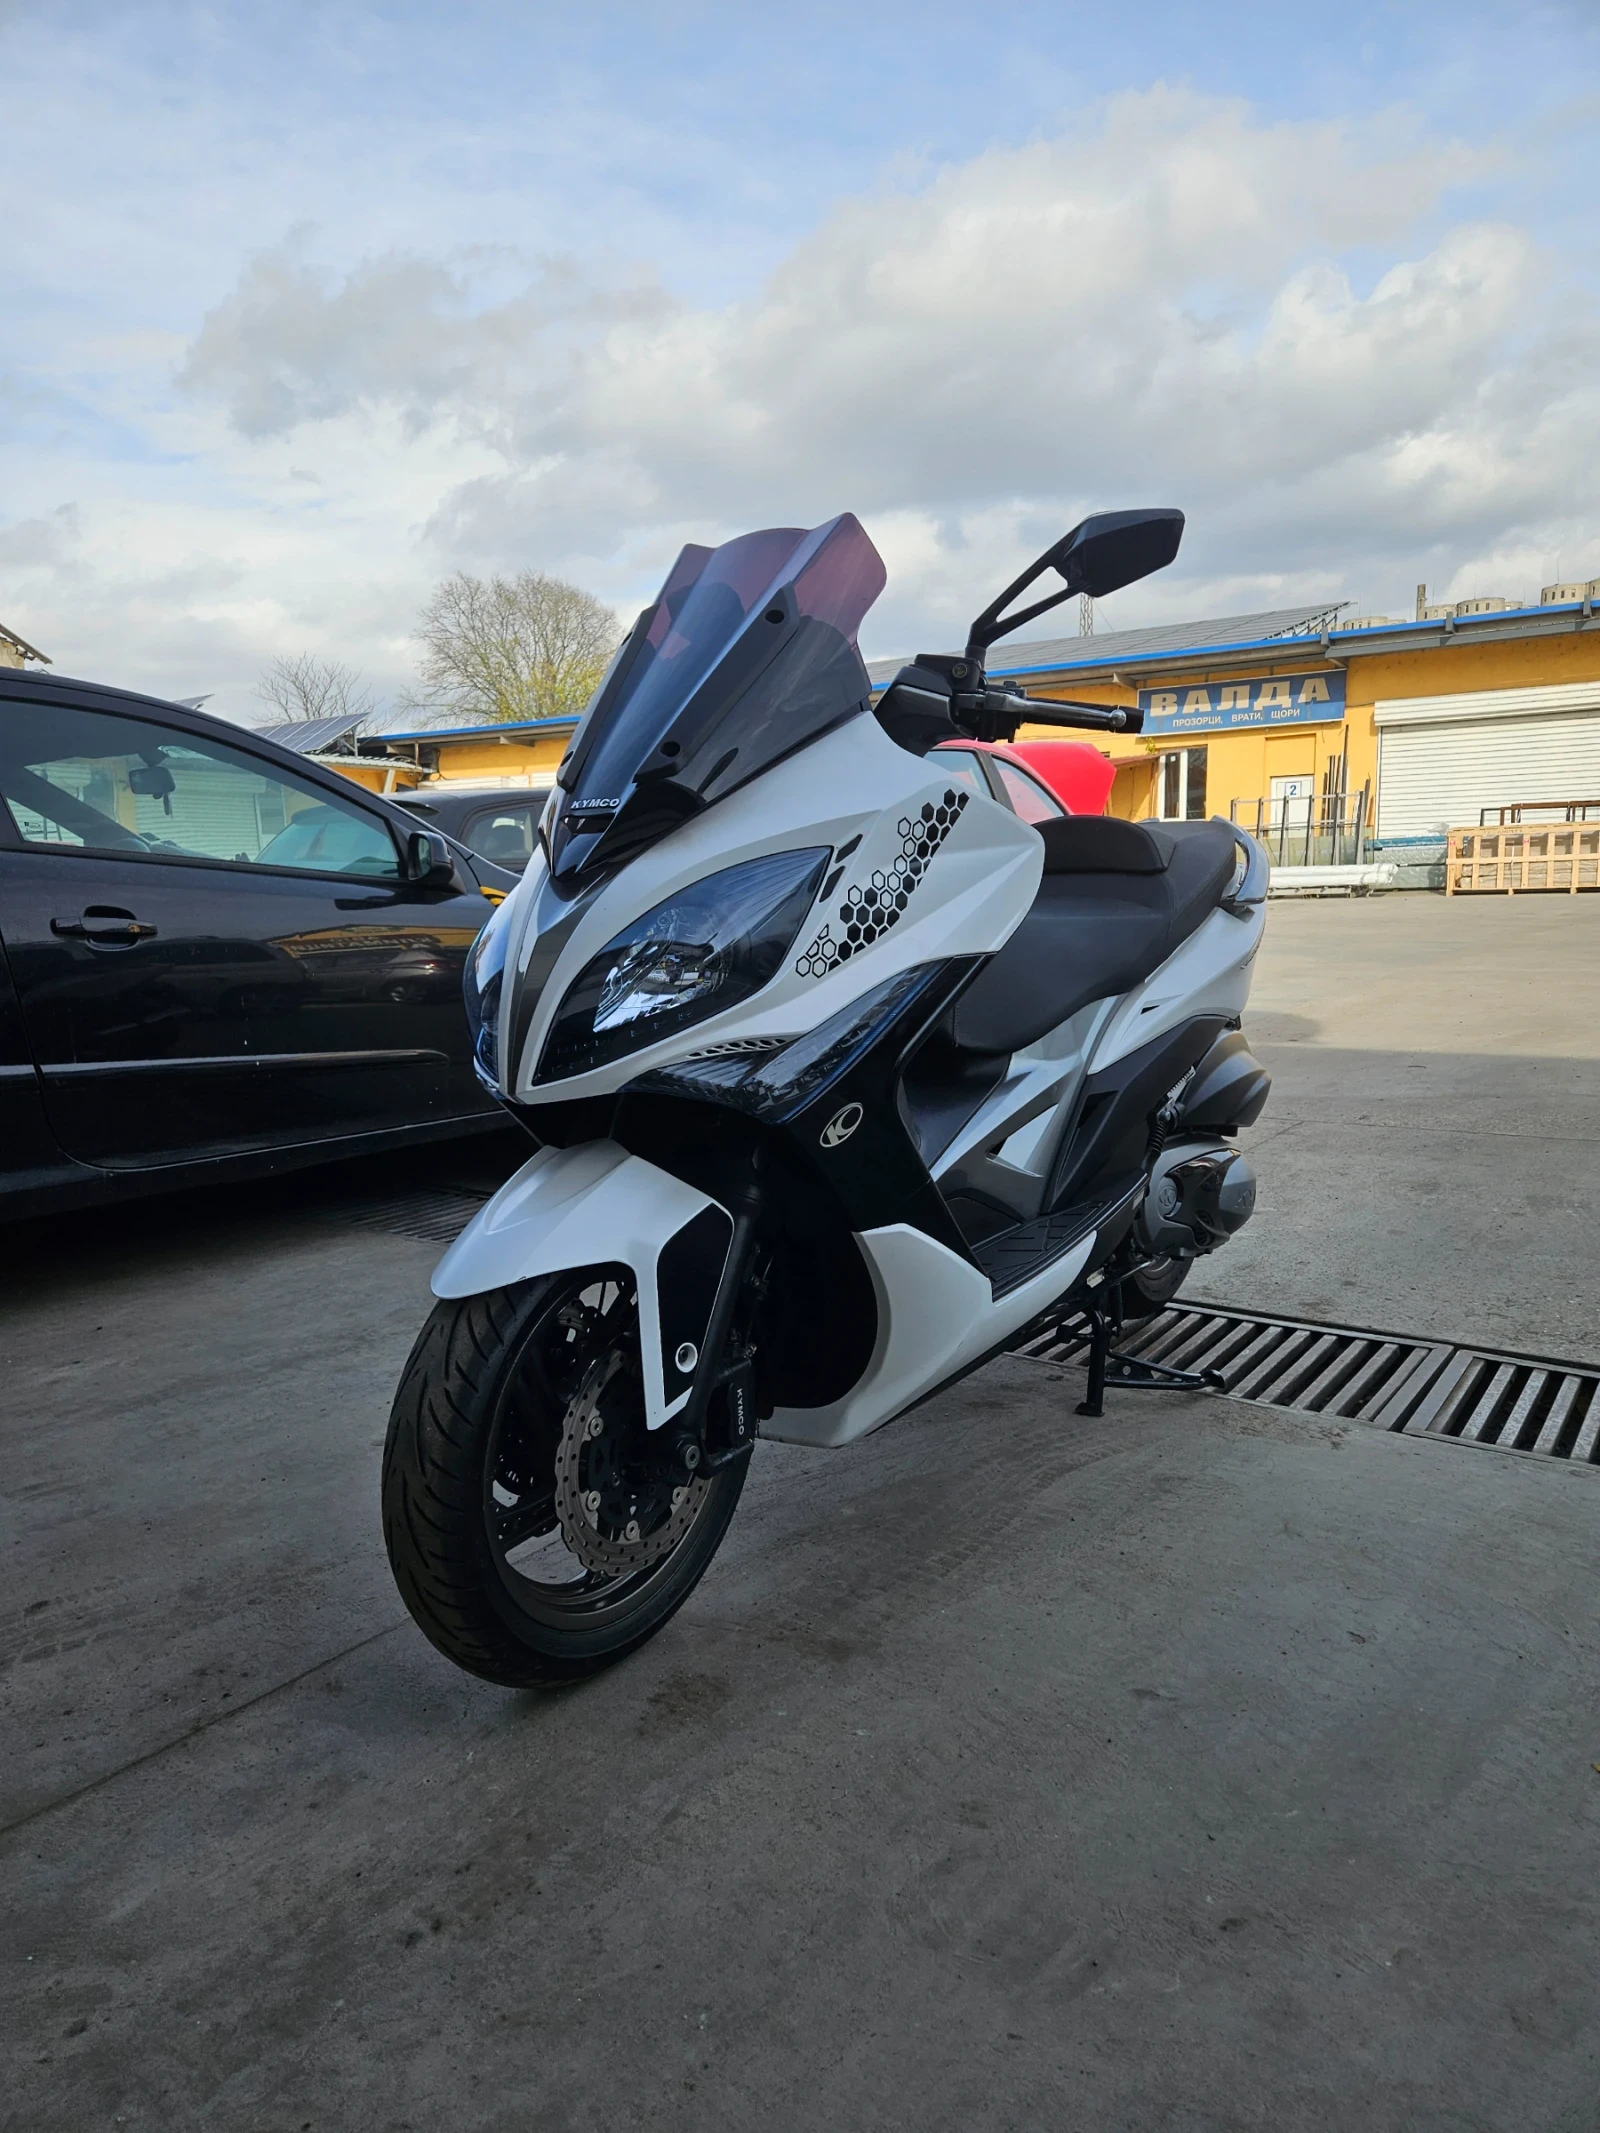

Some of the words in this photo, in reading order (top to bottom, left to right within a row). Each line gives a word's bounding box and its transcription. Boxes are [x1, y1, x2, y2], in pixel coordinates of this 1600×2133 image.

[1150, 677, 1330, 717] ВАЛДА
[1172, 715, 1223, 728] ПРОЗОРЦИ,
[1231, 711, 1264, 723] ВРАТИ,
[1271, 708, 1300, 719] ЩОРИ
[1289, 784, 1297, 796] 2
[570, 798, 620, 809] KYMCO
[736, 1388, 745, 1436] KYMCO
